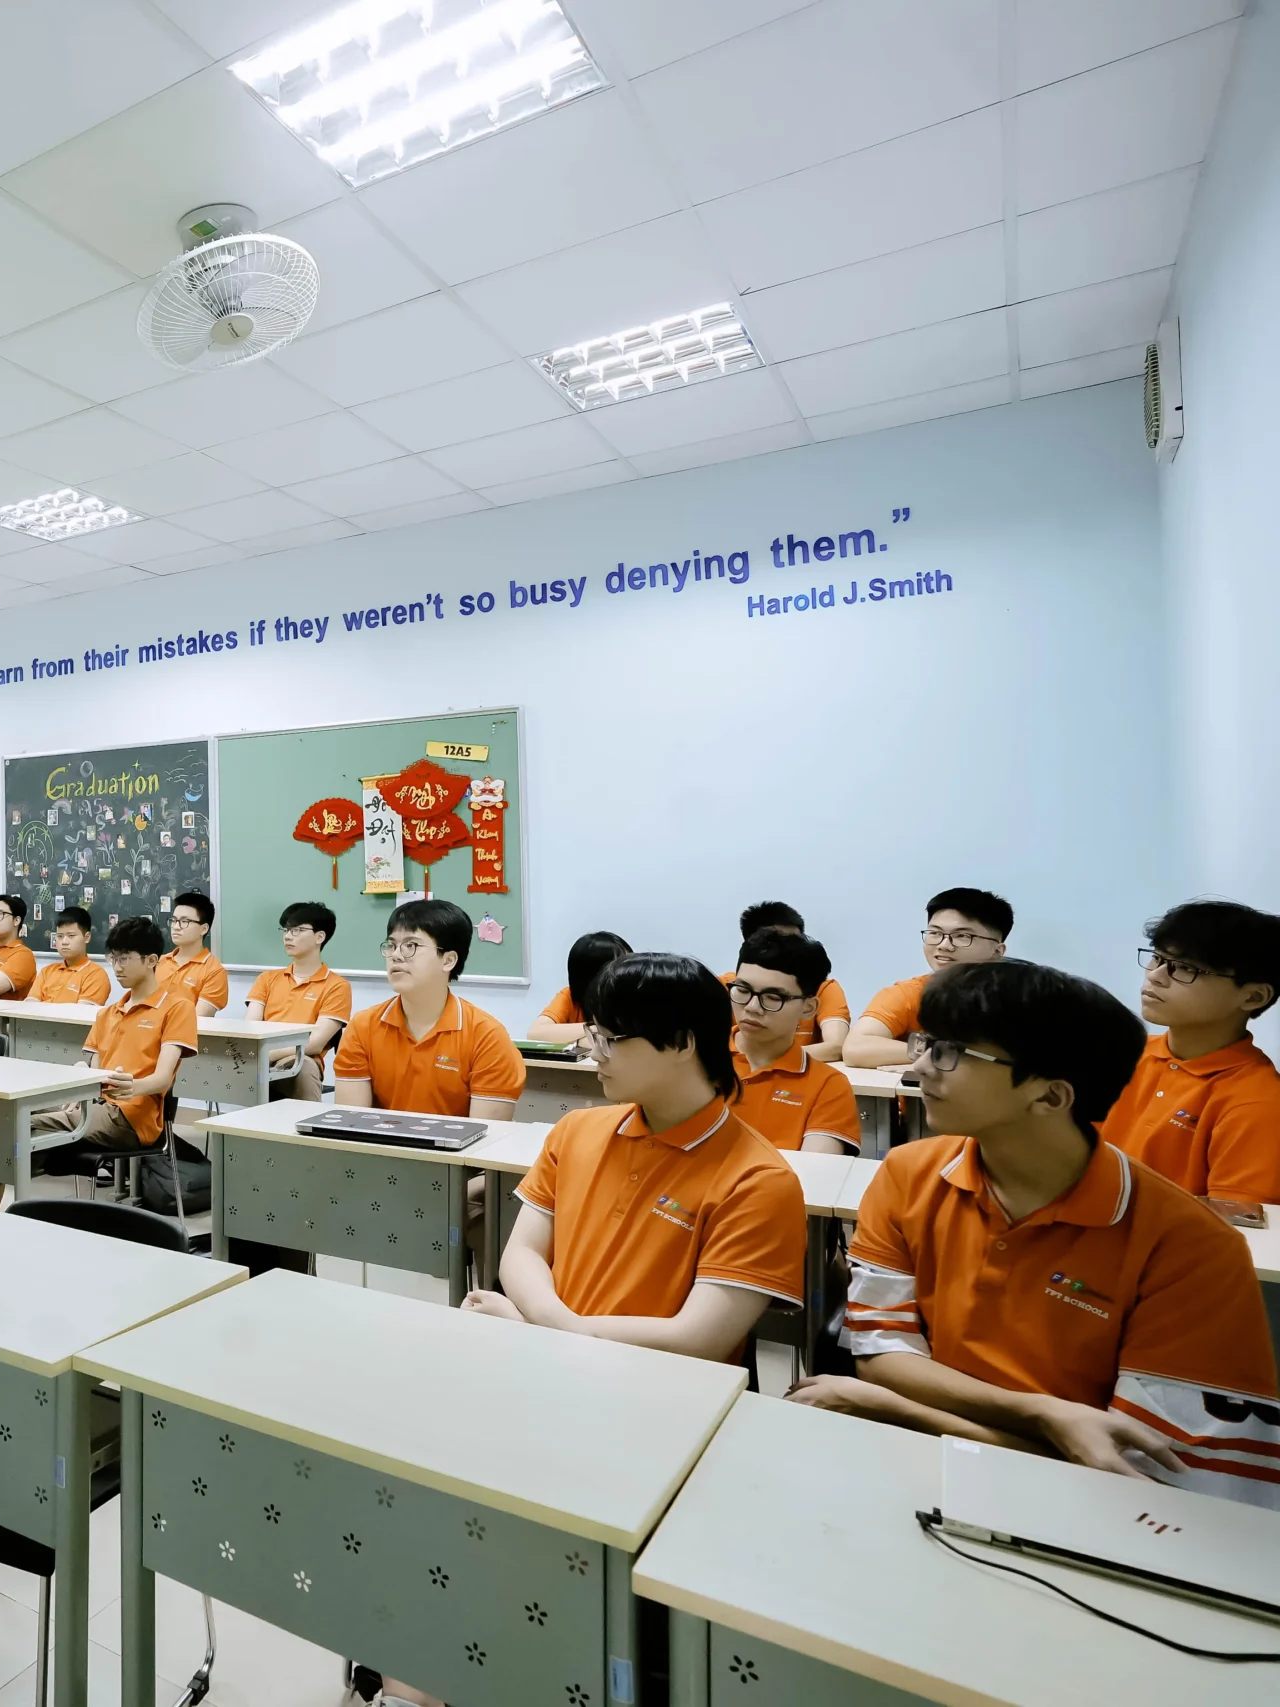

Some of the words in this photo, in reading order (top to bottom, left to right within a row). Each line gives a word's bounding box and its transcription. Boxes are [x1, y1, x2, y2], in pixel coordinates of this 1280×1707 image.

[31, 657, 75, 680] from
[83, 643, 129, 671] their
[138, 629, 239, 664] mistakes
[249, 619, 267, 647] if
[273, 615, 330, 643] they
[459, 591, 496, 617] so
[509, 576, 587, 609] busy
[604, 549, 750, 595] denying
[747, 584, 836, 618] Harold
[444, 745, 472, 757] 12A5
[46, 766, 160, 800] Graduation
